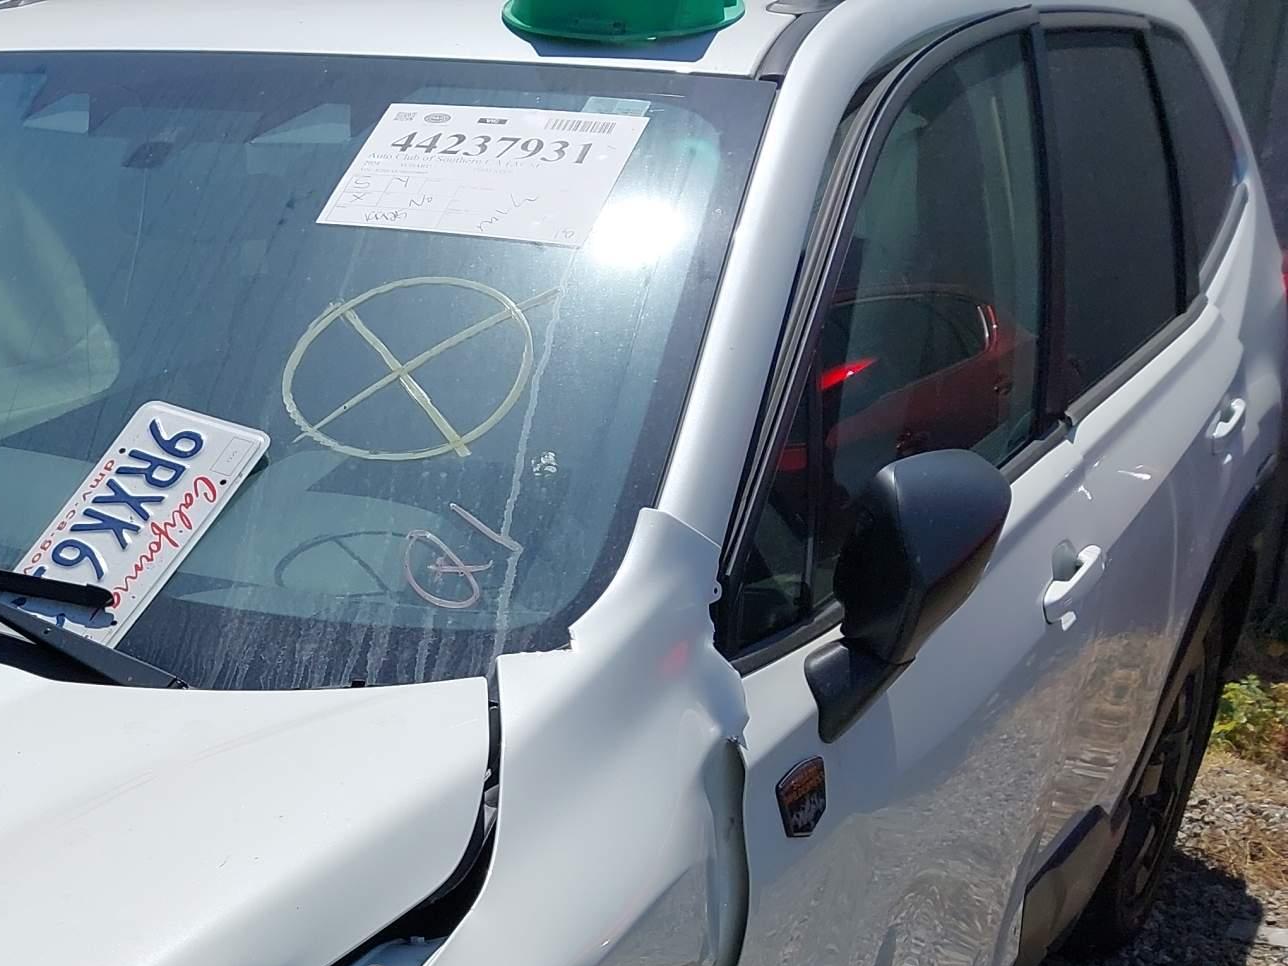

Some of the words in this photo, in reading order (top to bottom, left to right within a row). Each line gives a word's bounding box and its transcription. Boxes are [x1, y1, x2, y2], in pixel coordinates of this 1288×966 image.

[391, 131, 594, 165] 44237931
[395, 153, 418, 161] Club
[17, 417, 205, 622] 9RXK6
[110, 476, 218, 609] California
